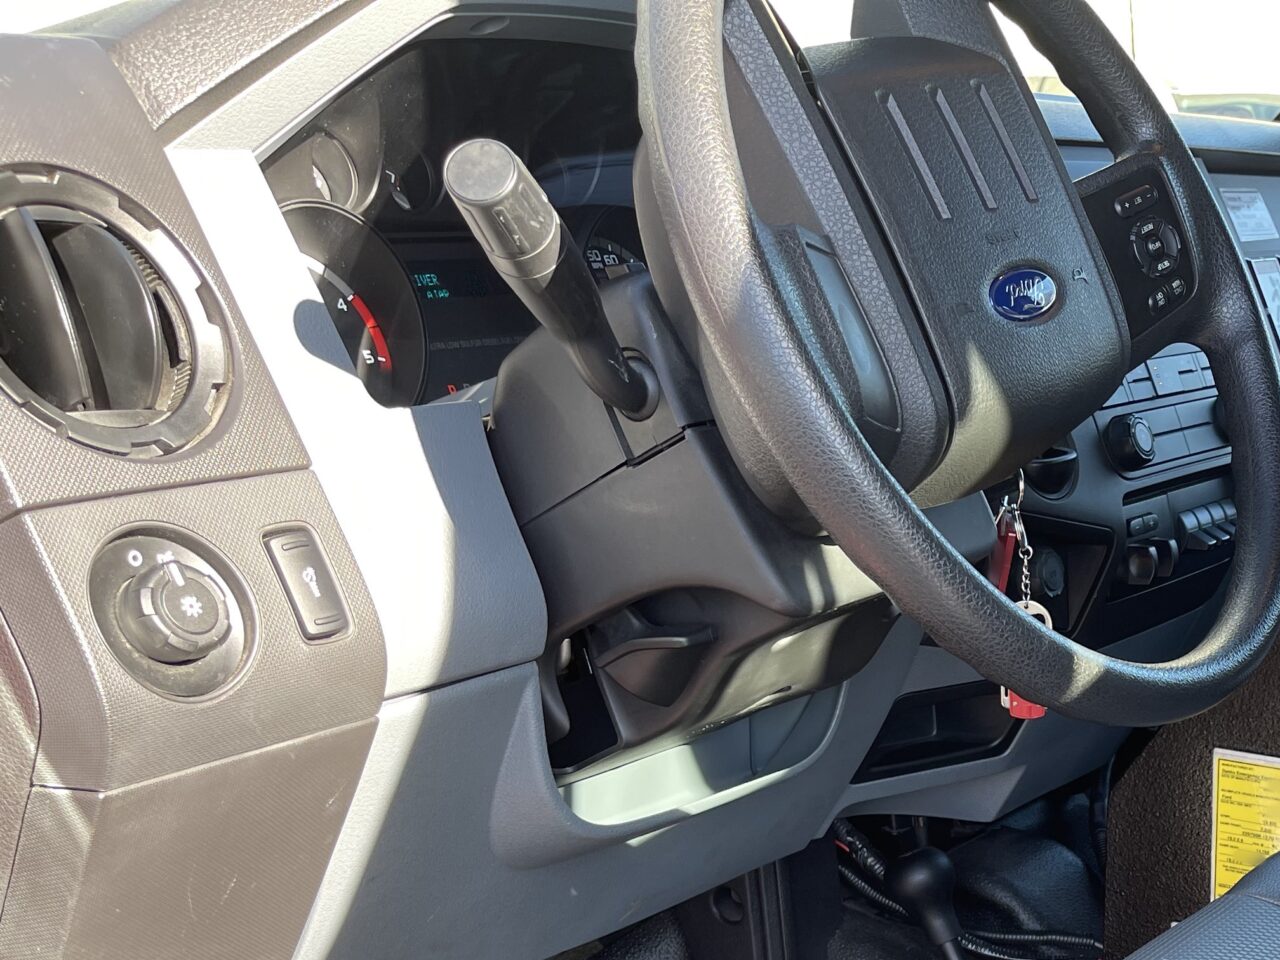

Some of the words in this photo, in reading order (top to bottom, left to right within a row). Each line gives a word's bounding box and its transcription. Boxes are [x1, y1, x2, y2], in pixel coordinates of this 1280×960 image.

[1141, 222, 1154, 234] RESET
[1157, 260, 1170, 271] SETUP
[414, 273, 440, 287] IVER
[1005, 276, 1046, 311] Ford
[337, 297, 348, 312] 4
[362, 349, 375, 364] 5
